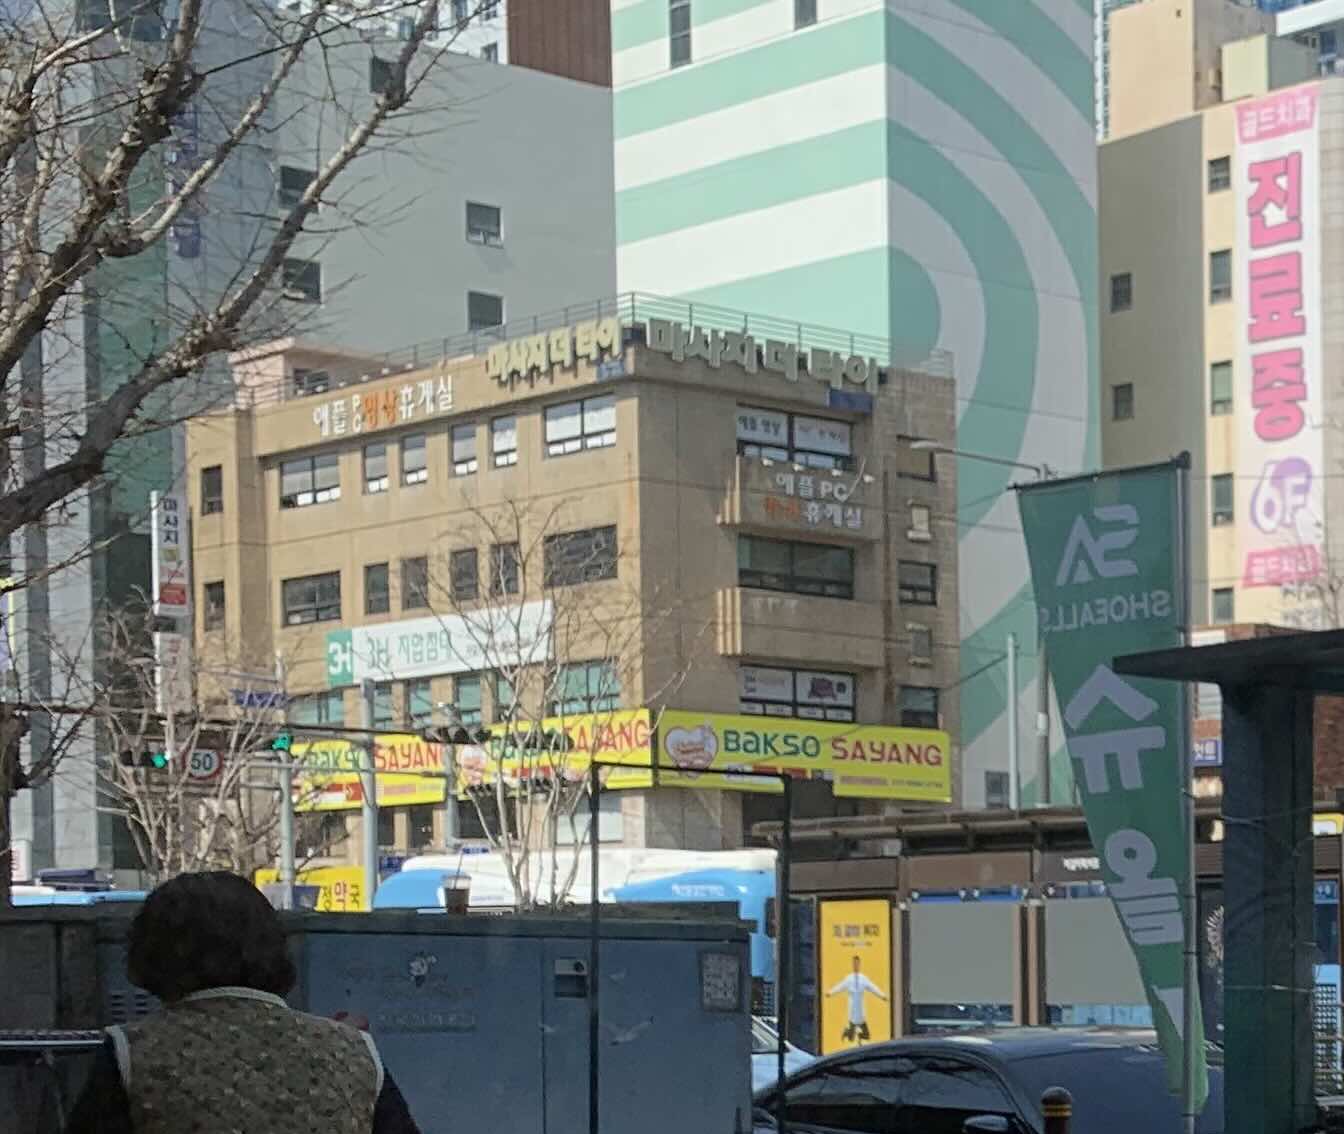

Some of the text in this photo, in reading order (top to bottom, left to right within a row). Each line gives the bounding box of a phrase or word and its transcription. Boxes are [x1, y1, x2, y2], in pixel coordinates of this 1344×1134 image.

[1247, 150, 1307, 441] 진료중
[820, 482, 848, 503] PC
[191, 753, 213, 771] 50
[374, 741, 443, 772] SAYAN
[831, 737, 943, 768] SAYANG
